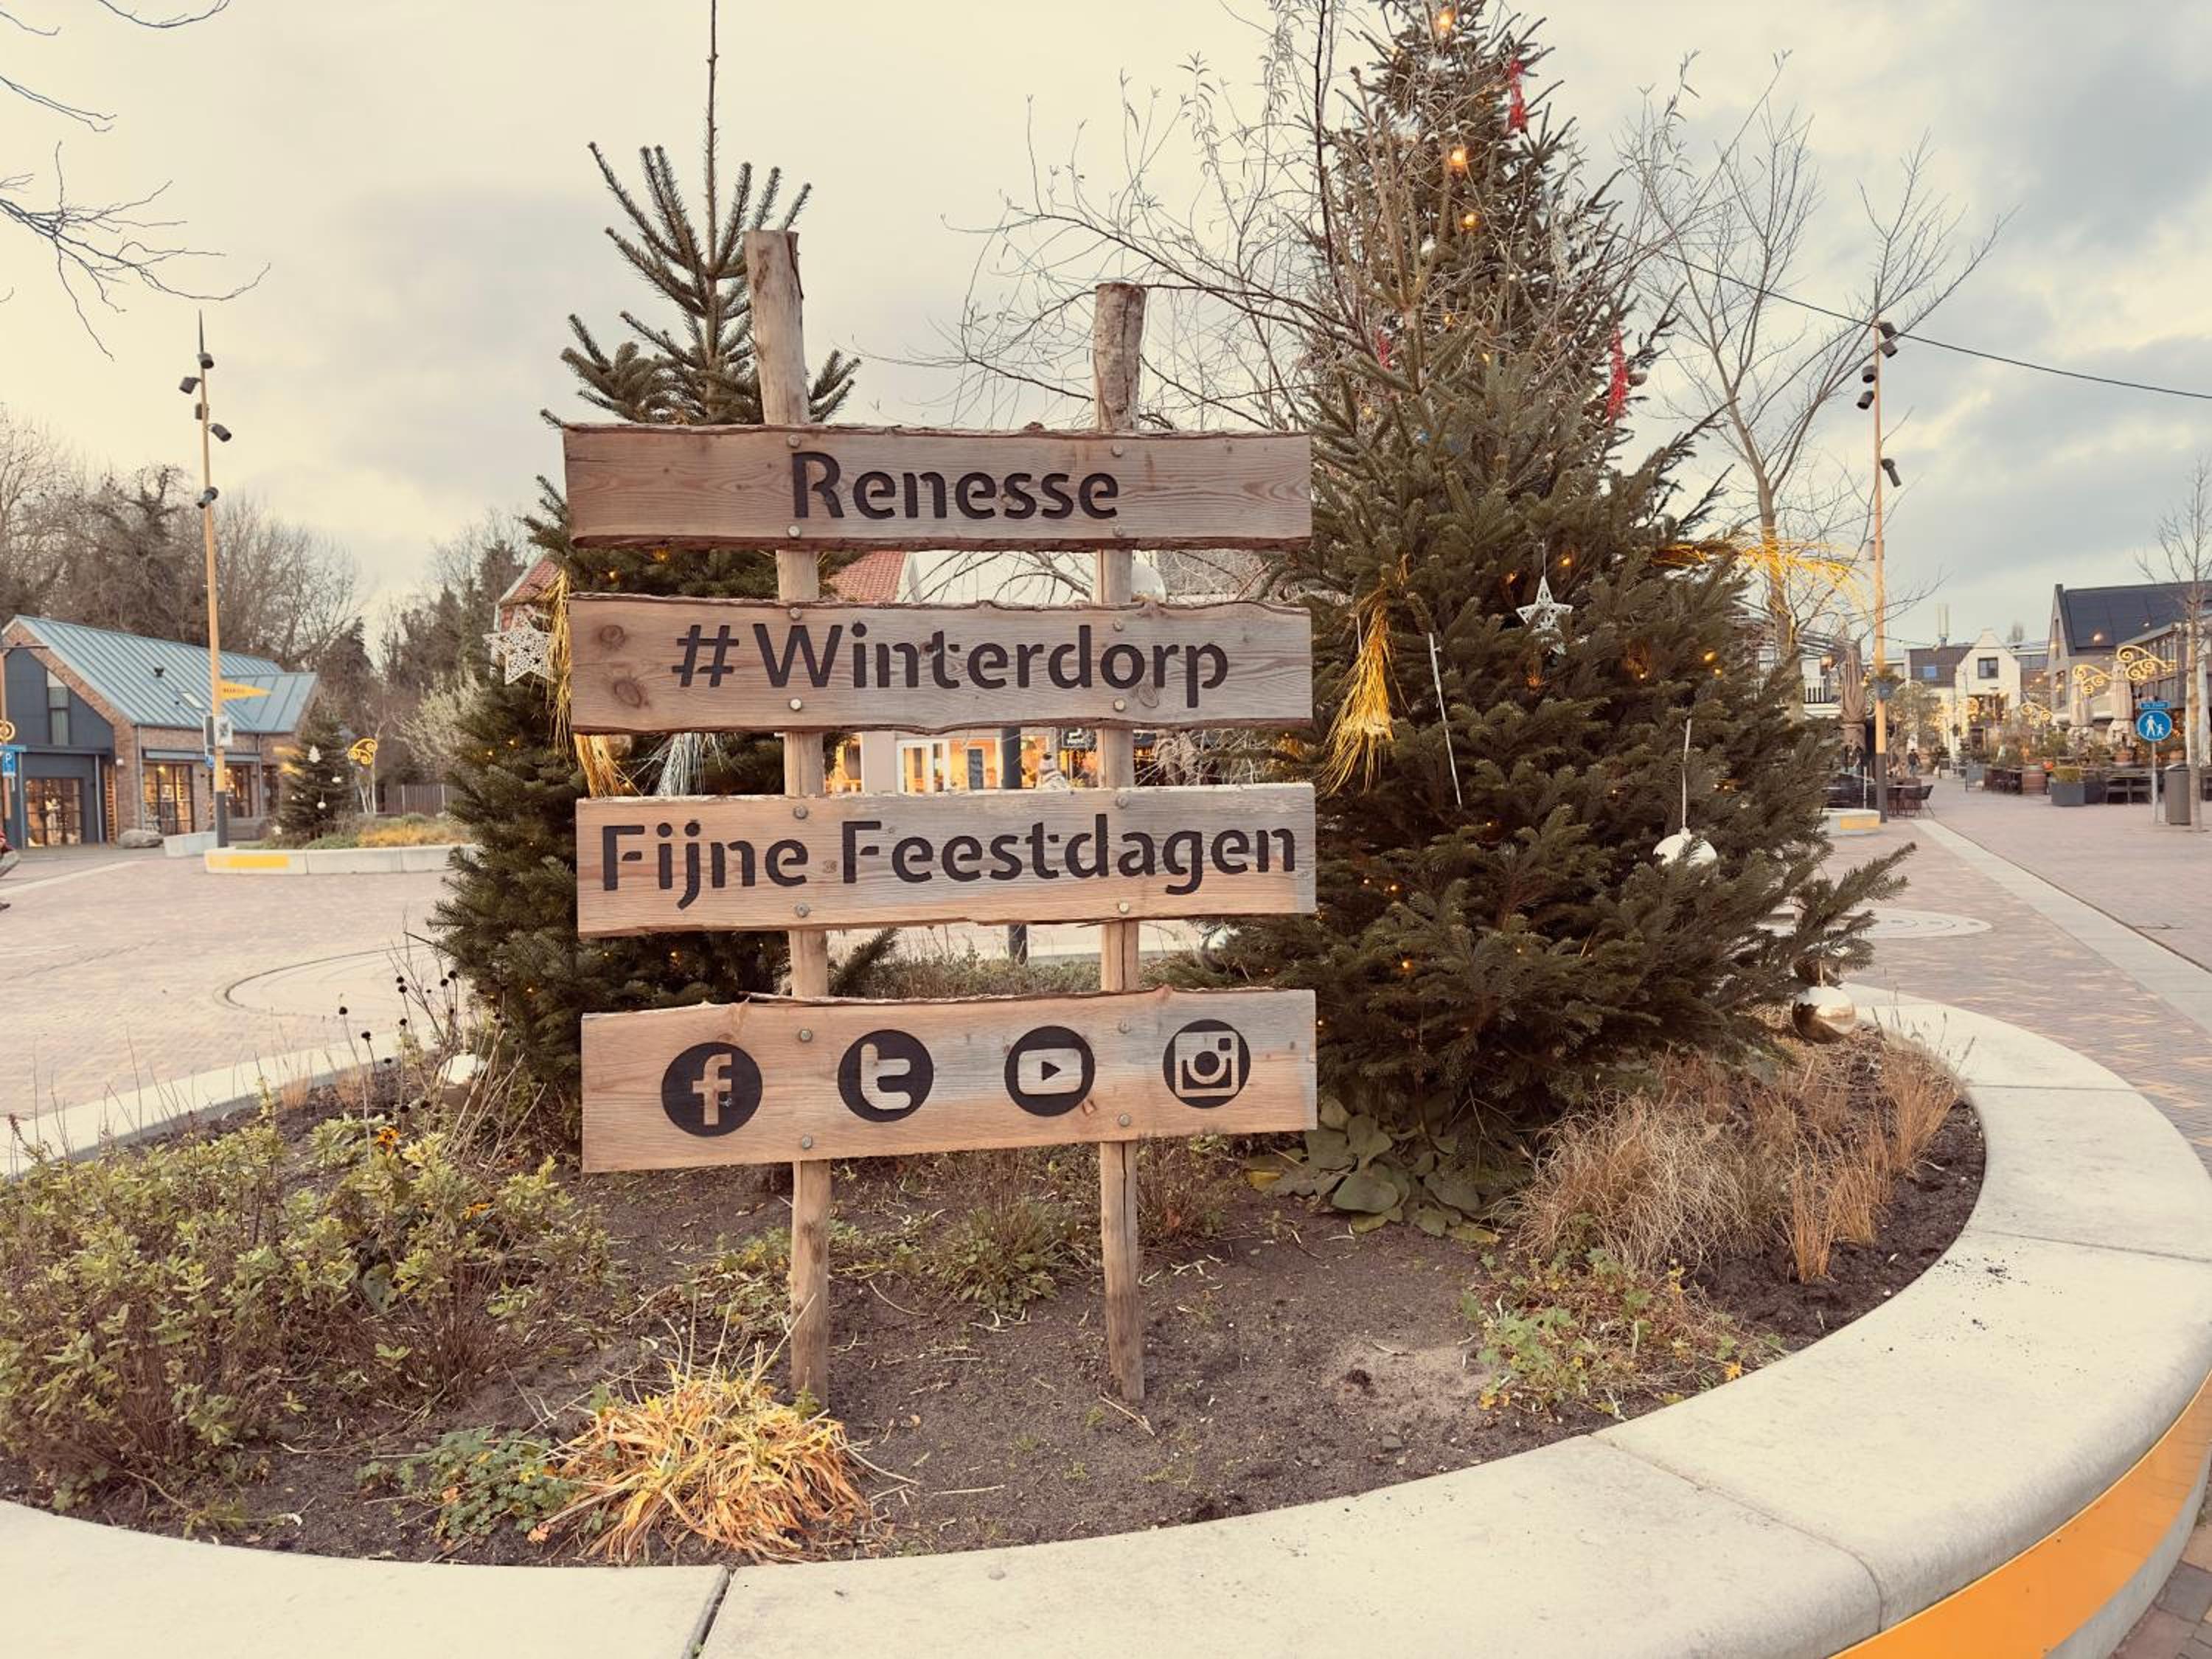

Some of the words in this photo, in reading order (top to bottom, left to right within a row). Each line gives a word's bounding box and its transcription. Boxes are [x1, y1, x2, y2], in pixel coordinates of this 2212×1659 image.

[791, 451, 1118, 520] Renesse
[672, 623, 1229, 708] #Winterdorp
[603, 820, 809, 910] Fijne
[843, 814, 1295, 895] Feestdagen
